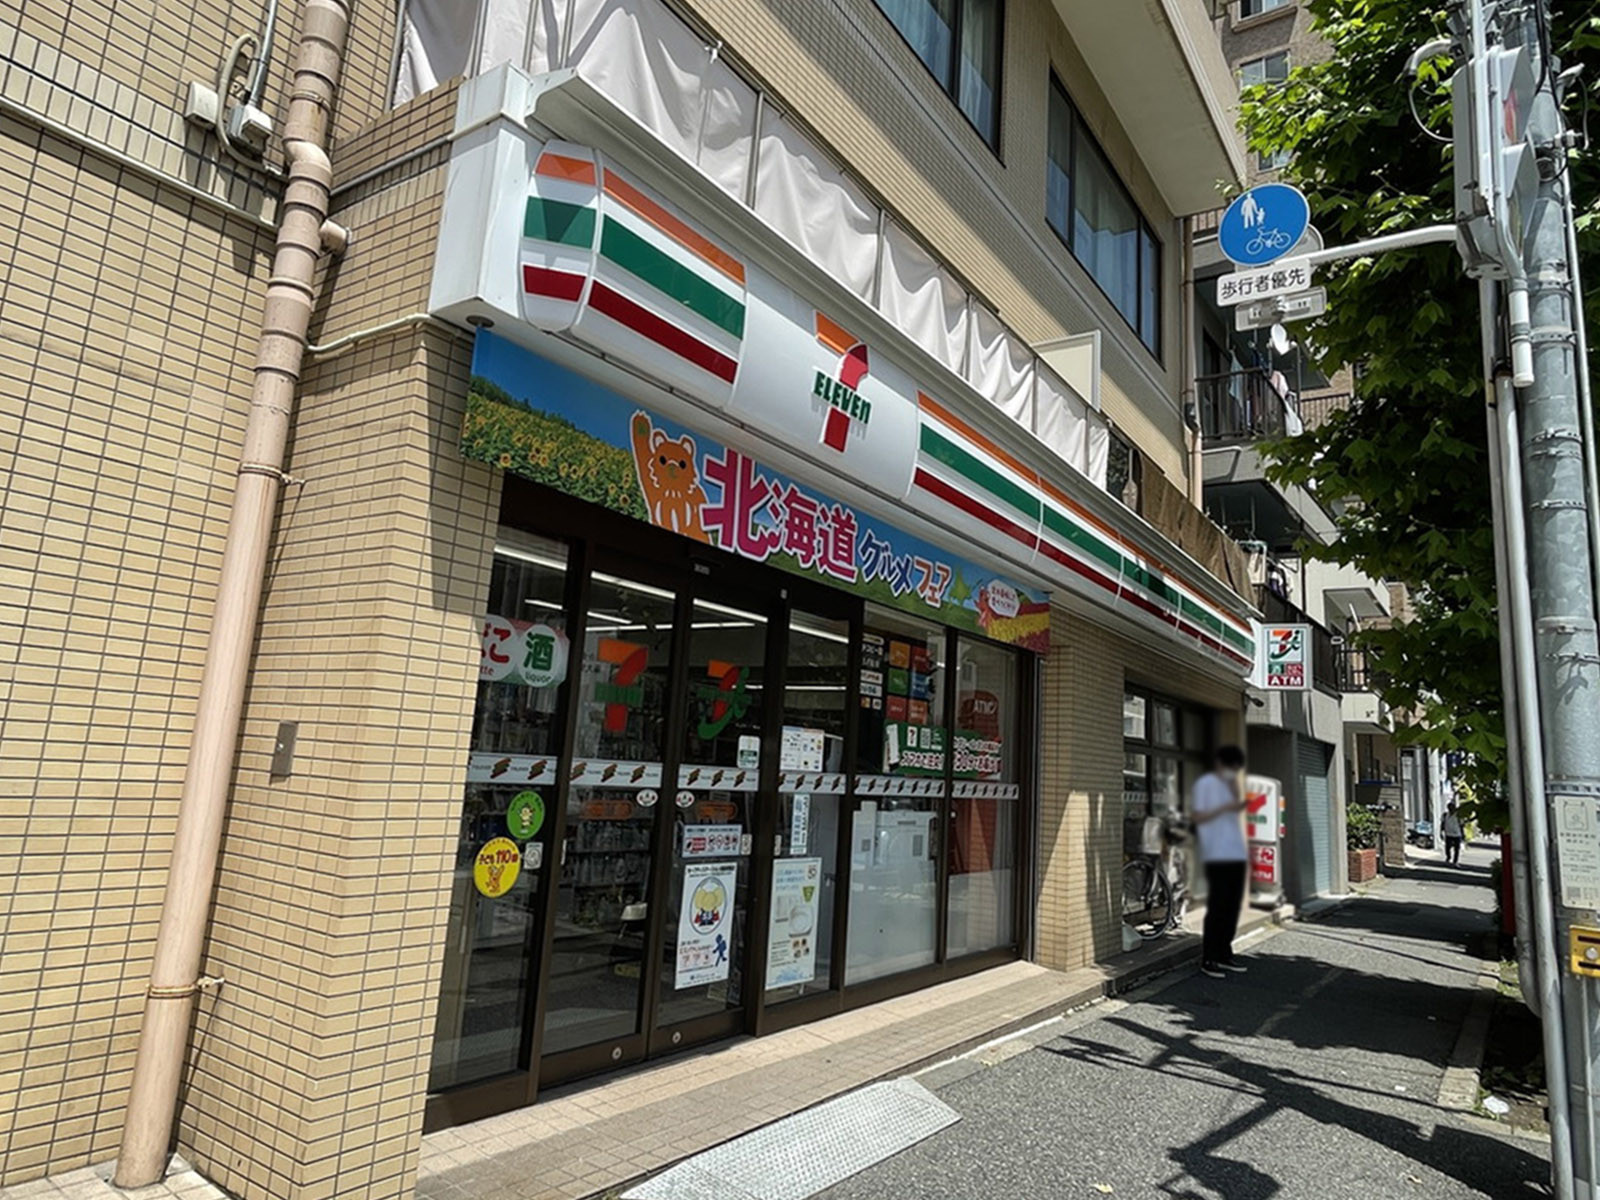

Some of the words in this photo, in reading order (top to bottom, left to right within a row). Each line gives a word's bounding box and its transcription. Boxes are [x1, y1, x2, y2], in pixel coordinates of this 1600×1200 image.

[1221, 268, 1306, 299] 歩行者優先
[523, 631, 556, 672] 酒
[1271, 675, 1302, 685] ATM
